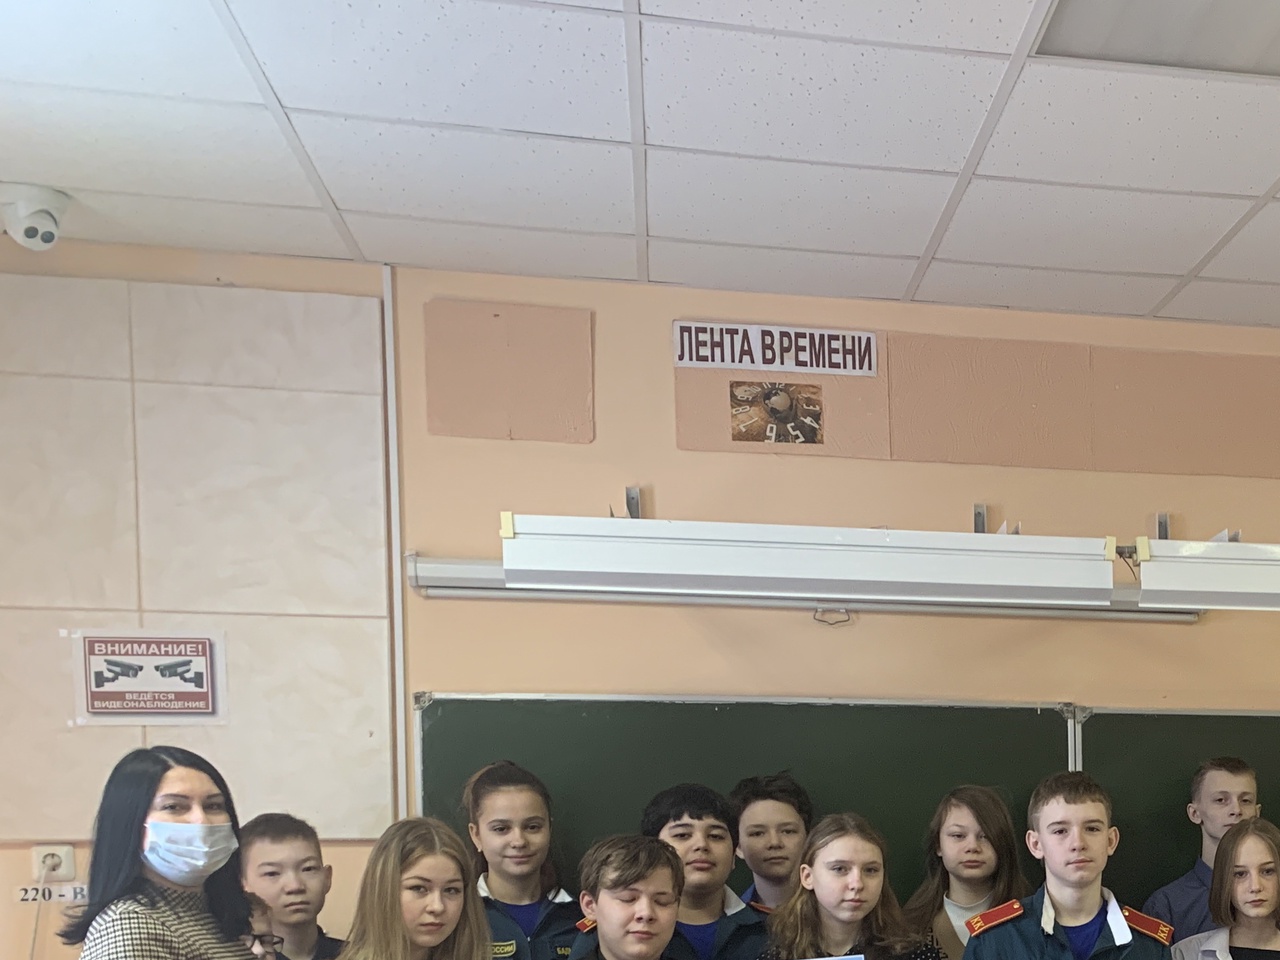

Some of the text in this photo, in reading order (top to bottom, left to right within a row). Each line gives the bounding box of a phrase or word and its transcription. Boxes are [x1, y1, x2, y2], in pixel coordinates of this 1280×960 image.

[677, 325, 873, 371] ЛЕНТА ВРЕМЕНИ
[94, 642, 203, 655] ВНИМАНИЕ!
[94, 700, 206, 709] ВИДЕОНАБЛЮДЕНИЕ
[19, 887, 52, 901] 220
[492, 944, 514, 954] ОССИИ
